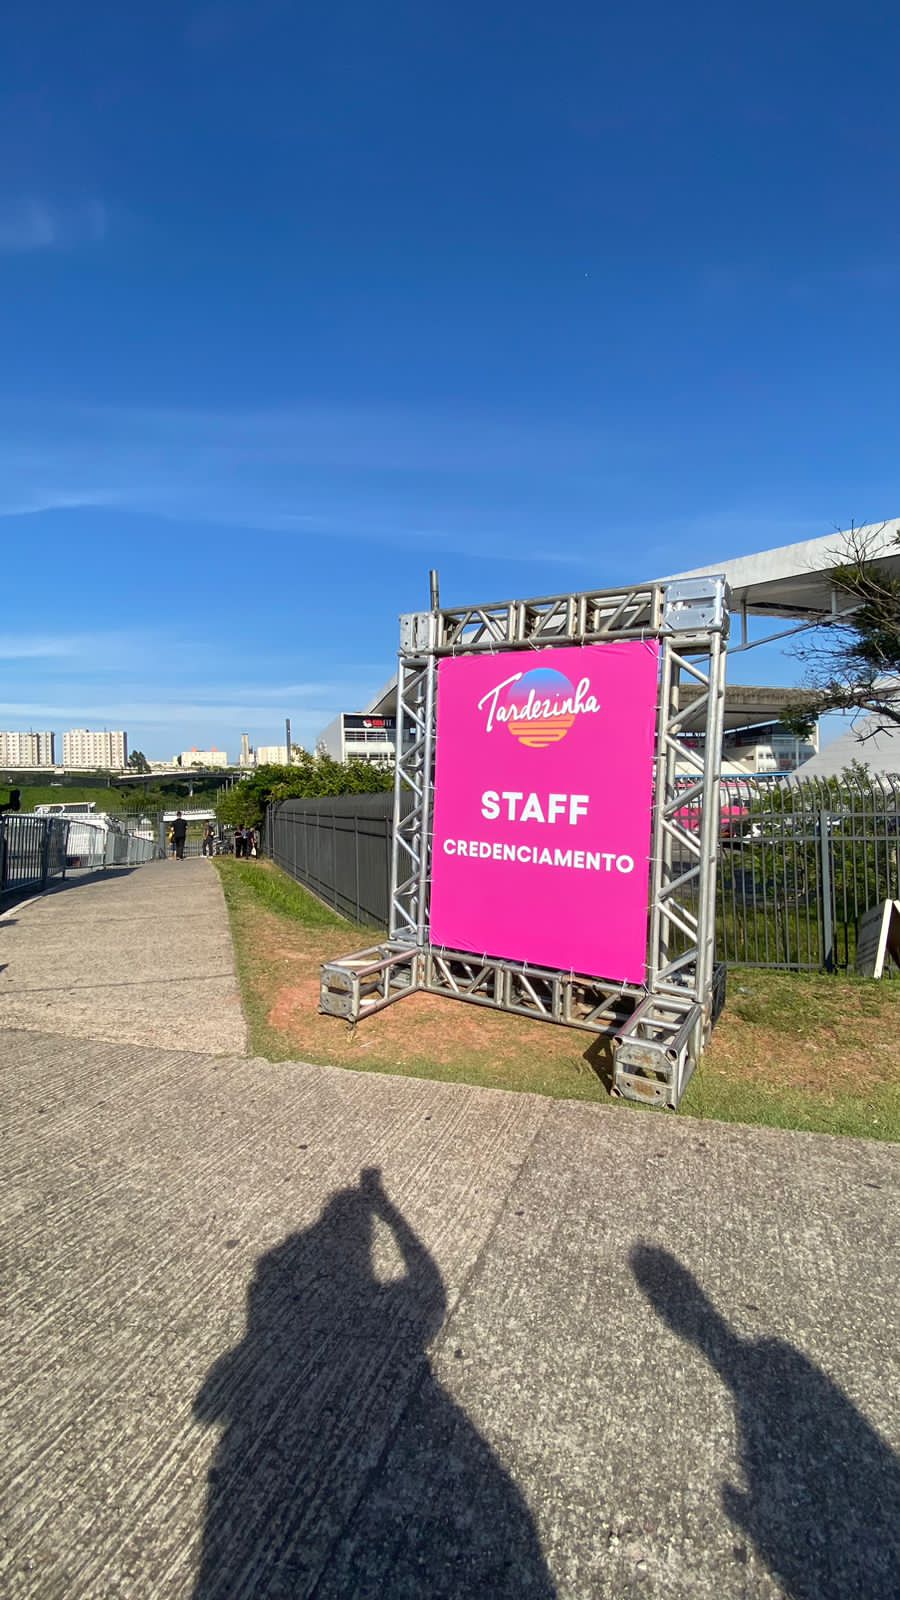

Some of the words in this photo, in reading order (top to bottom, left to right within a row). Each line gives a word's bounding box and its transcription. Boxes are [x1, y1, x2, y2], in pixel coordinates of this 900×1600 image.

[478, 671, 600, 732] Tardezinha
[481, 790, 590, 825] STAFF
[443, 838, 635, 874] CREDENCIAMENTO
